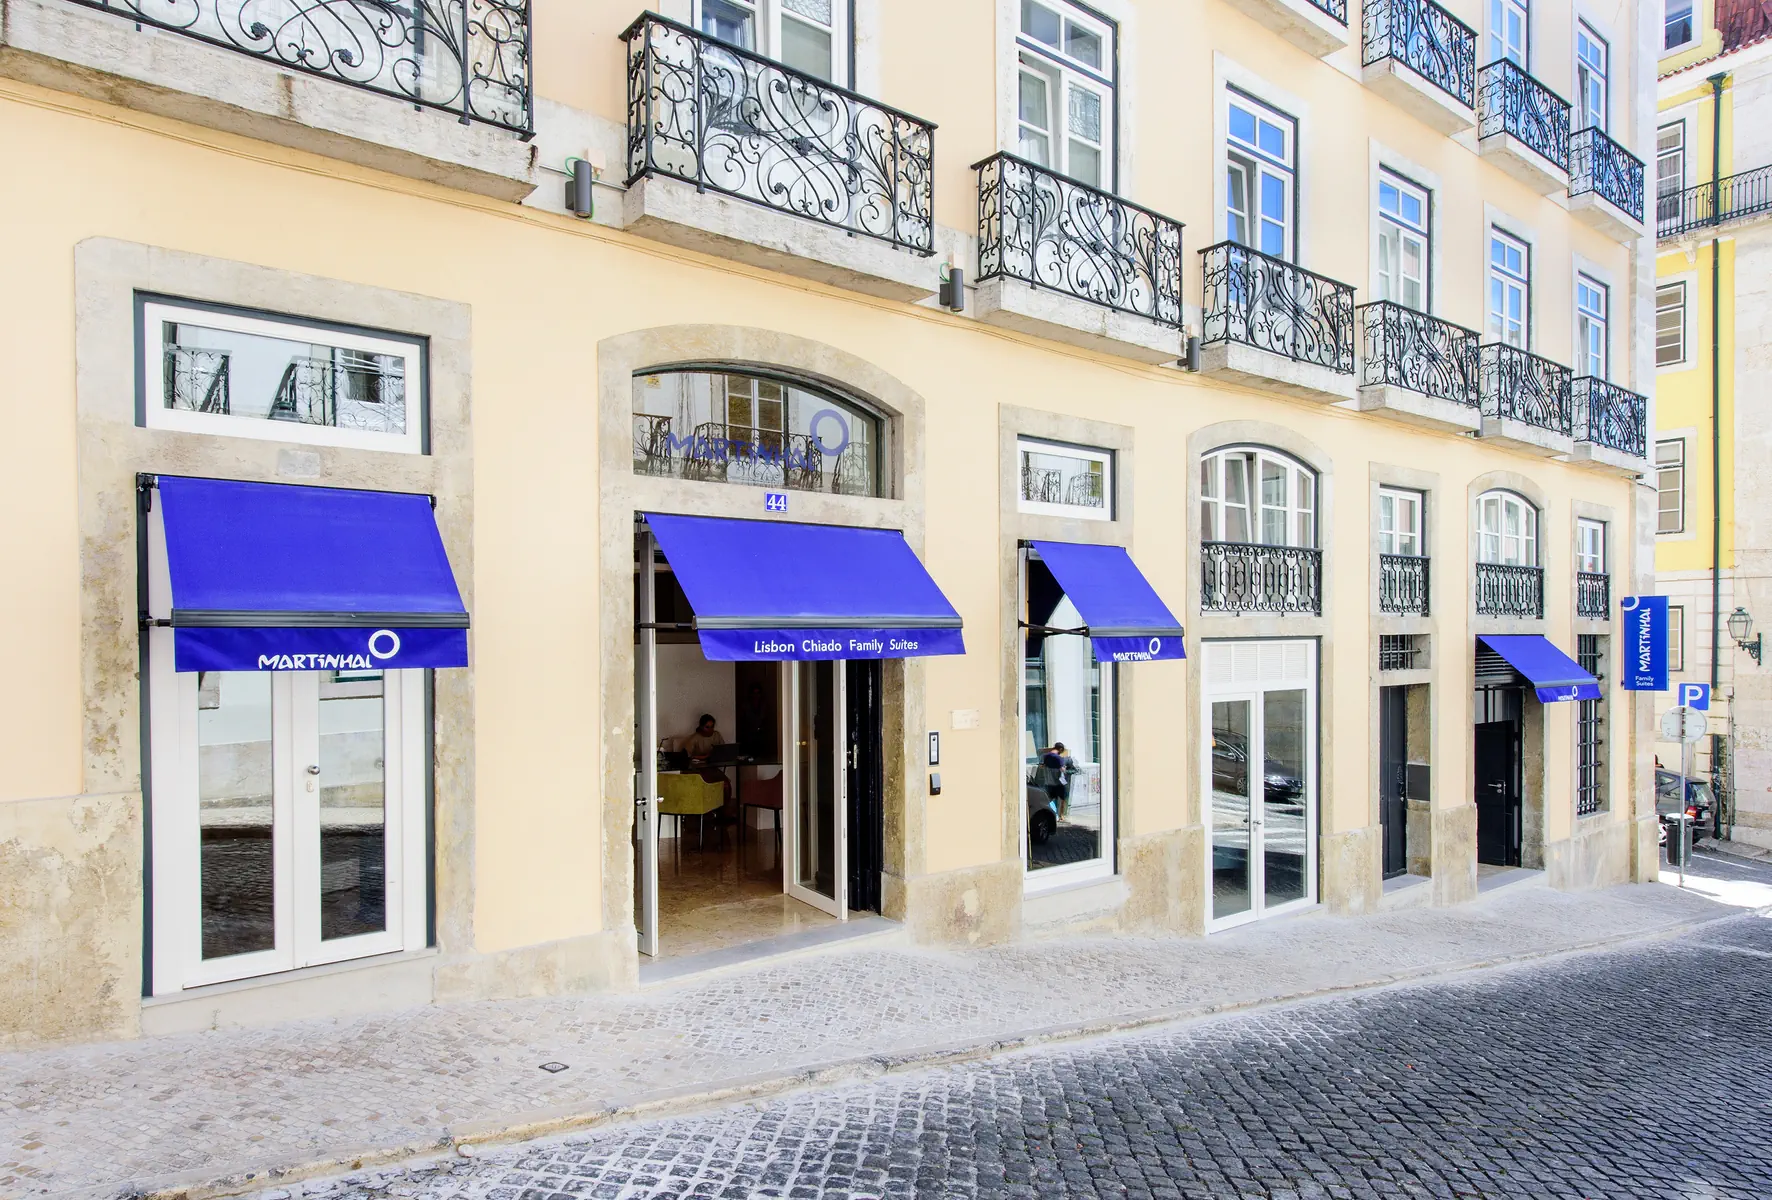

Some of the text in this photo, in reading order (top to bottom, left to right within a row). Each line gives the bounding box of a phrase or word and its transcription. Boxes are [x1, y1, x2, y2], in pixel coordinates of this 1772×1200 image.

[767, 494, 786, 511] 44
[754, 638, 919, 654] Lisbon Chiado Family Suites
[1635, 675, 1654, 683] Family
[1684, 685, 1703, 707] P
